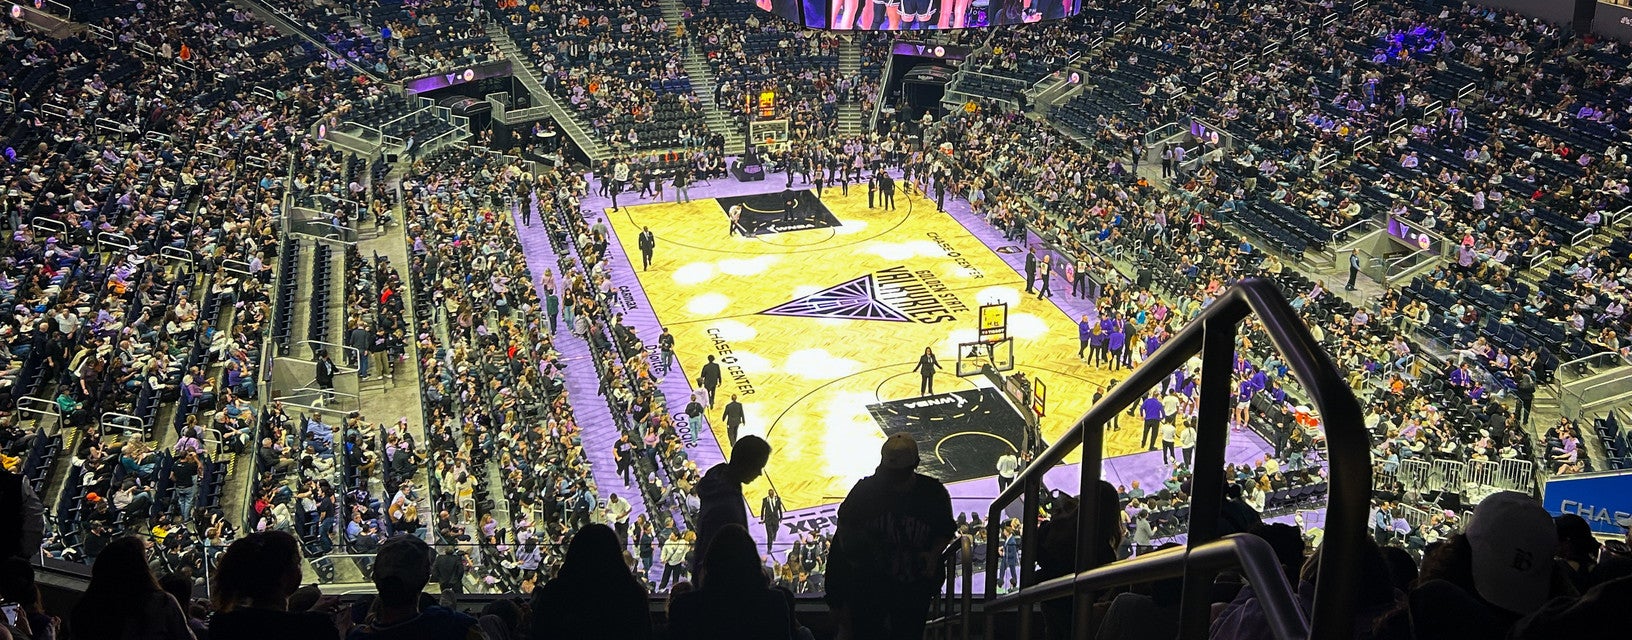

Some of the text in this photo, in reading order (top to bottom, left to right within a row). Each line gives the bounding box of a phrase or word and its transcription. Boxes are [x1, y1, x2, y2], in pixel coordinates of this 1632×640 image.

[775, 223, 816, 231] WNBA
[876, 265, 957, 324] VALKYRIES
[915, 270, 970, 313] GOLDEN STATE
[707, 327, 756, 396] CHASE CENTER
[903, 396, 956, 409] WNBA
